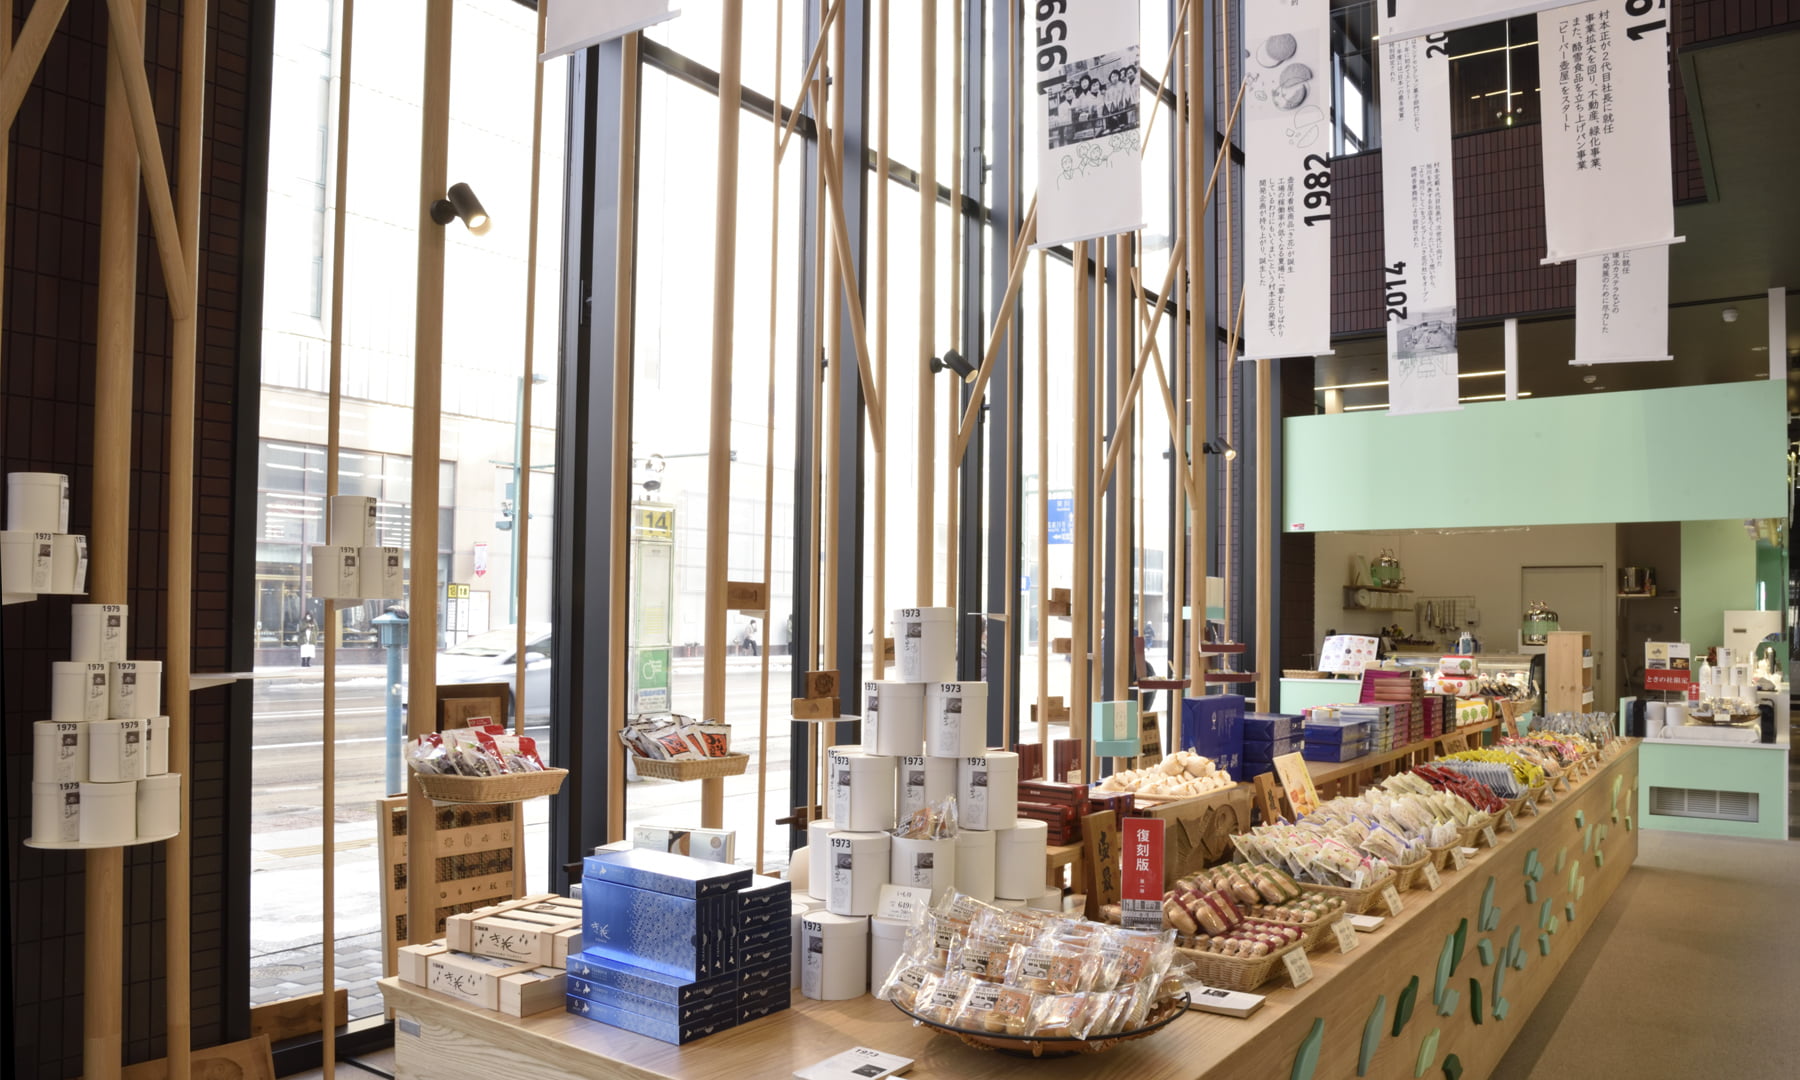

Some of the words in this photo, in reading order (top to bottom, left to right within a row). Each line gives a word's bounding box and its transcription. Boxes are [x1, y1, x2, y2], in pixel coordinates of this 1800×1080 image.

[1036, 0, 1067, 95] 1959
[1303, 152, 1331, 227] 1982
[1384, 261, 1407, 321] 2014
[645, 511, 668, 529] 14
[902, 609, 920, 617] 1973
[865, 683, 877, 691] 1973
[941, 684, 961, 693] 1973
[121, 721, 139, 729] 1979
[835, 757, 849, 765] 1973
[904, 757, 924, 765] 1973
[967, 758, 986, 766] 1973
[60, 782, 79, 790] 1979
[832, 839, 851, 848] 1973
[1136, 829, 1150, 871] 復刻版
[804, 921, 822, 931] 1973
[489, 932, 532, 955] き花
[444, 971, 479, 996] き花
